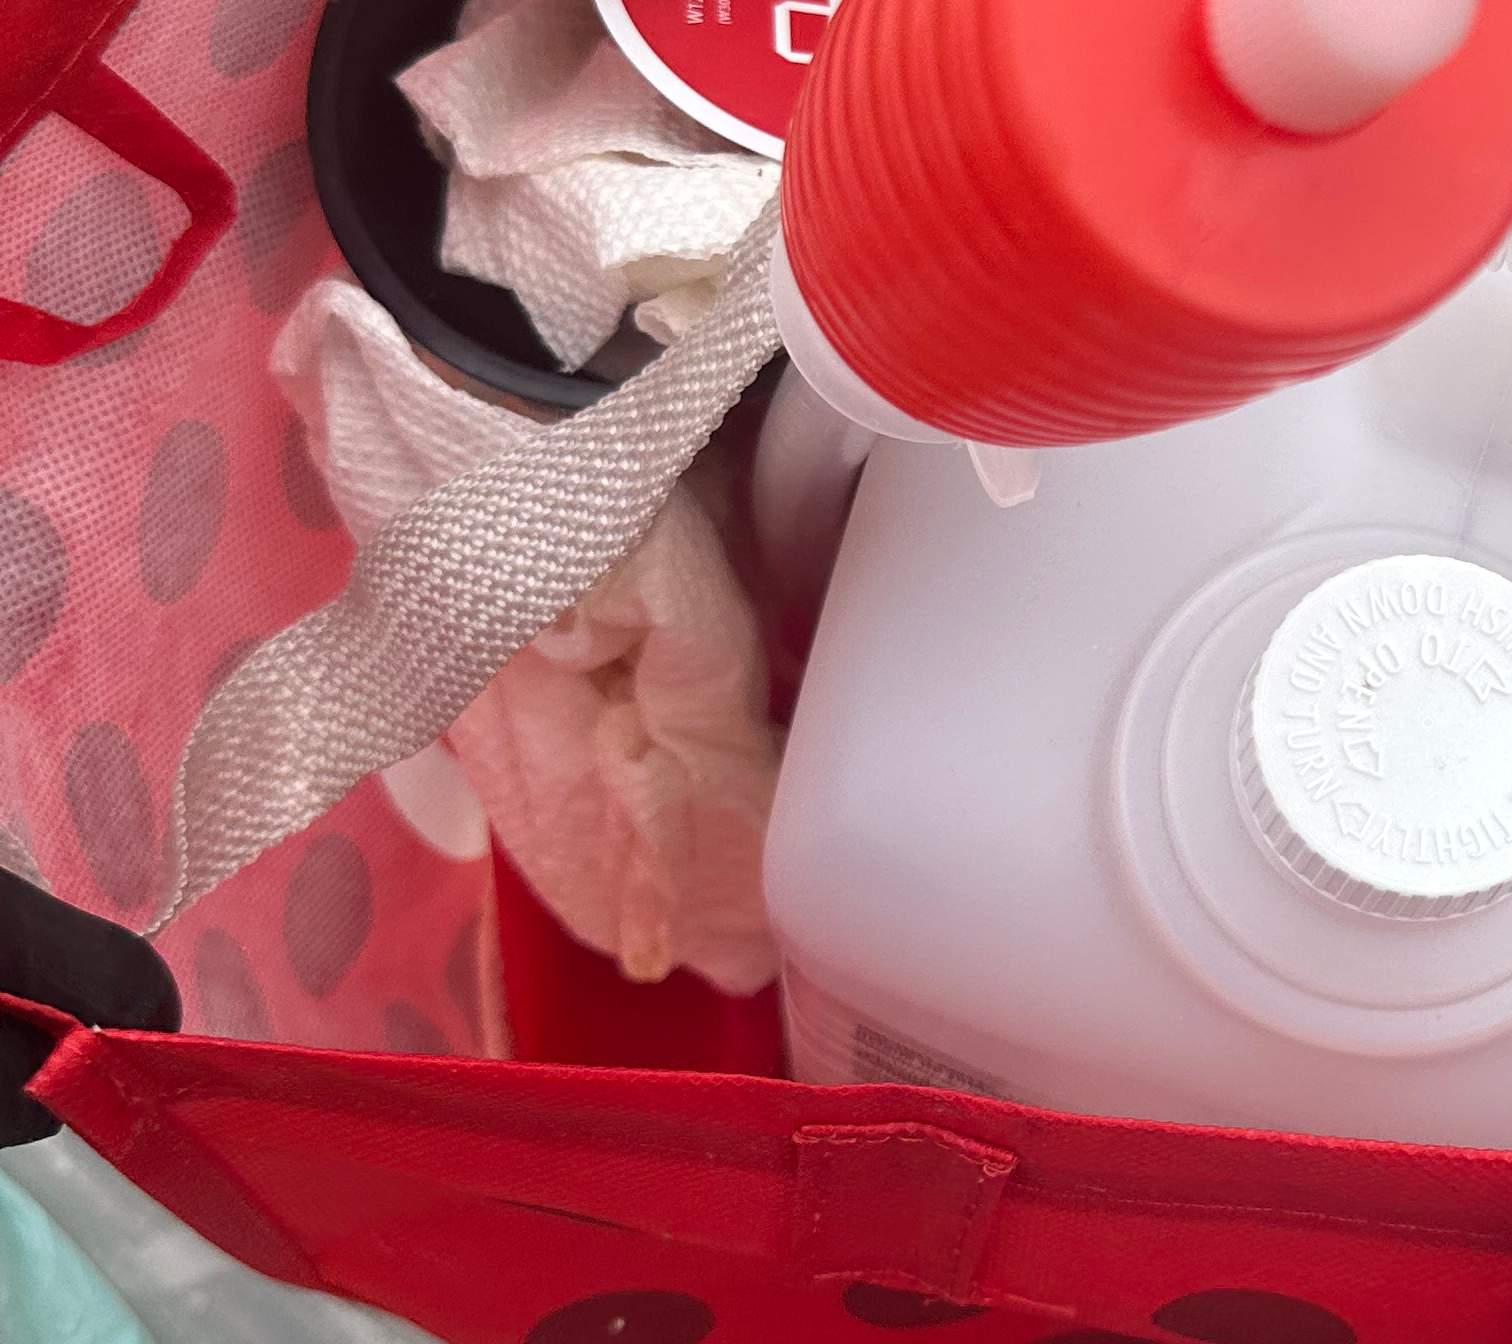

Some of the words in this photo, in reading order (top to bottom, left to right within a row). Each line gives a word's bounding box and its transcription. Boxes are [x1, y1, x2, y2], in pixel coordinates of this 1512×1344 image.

[1335, 580, 1447, 639] DOWN
[1288, 624, 1342, 695] AND
[1335, 642, 1401, 734] OPEN
[1420, 631, 1470, 678] TO
[1280, 702, 1343, 804] TURN
